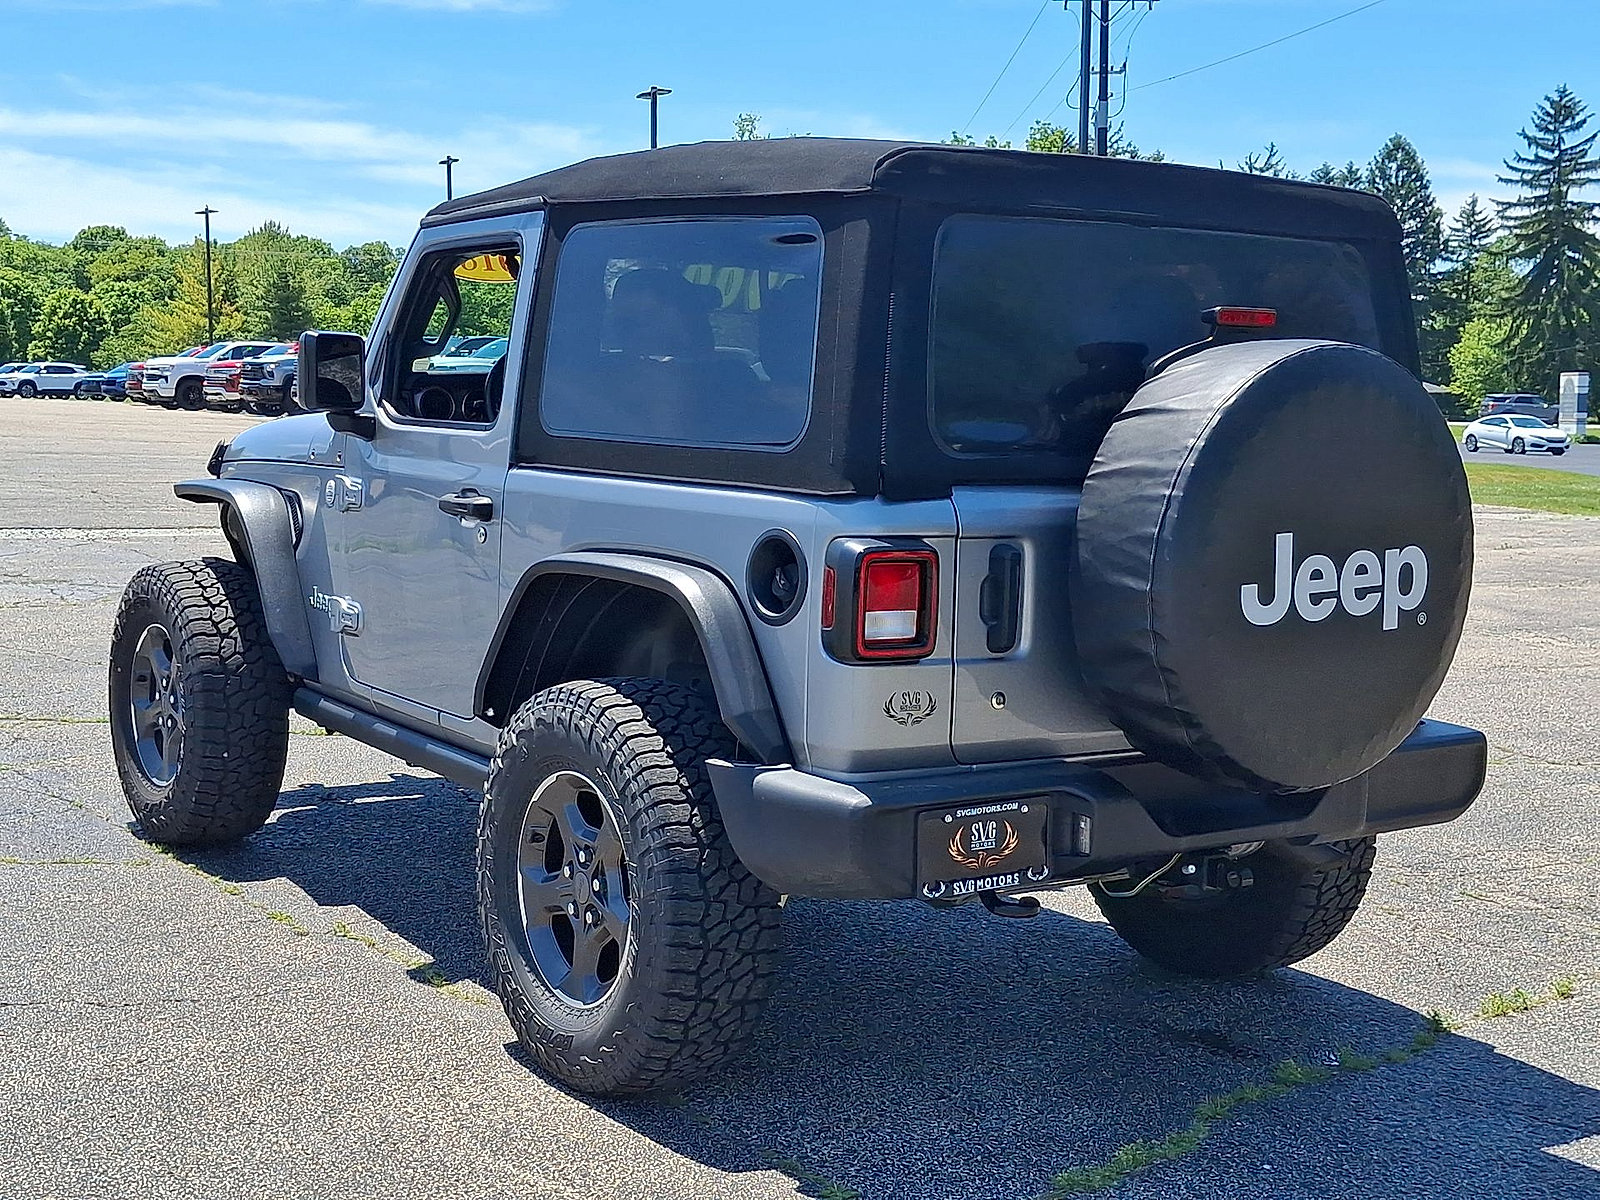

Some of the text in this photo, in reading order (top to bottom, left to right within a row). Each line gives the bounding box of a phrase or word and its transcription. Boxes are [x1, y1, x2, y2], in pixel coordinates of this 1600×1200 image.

[1240, 532, 1428, 631] Jeep
[901, 690, 921, 706] SVG
[956, 802, 1018, 817] SVGMOTORS.COM
[971, 820, 997, 841] SVG
[953, 872, 1020, 894] SVG MOTORS
